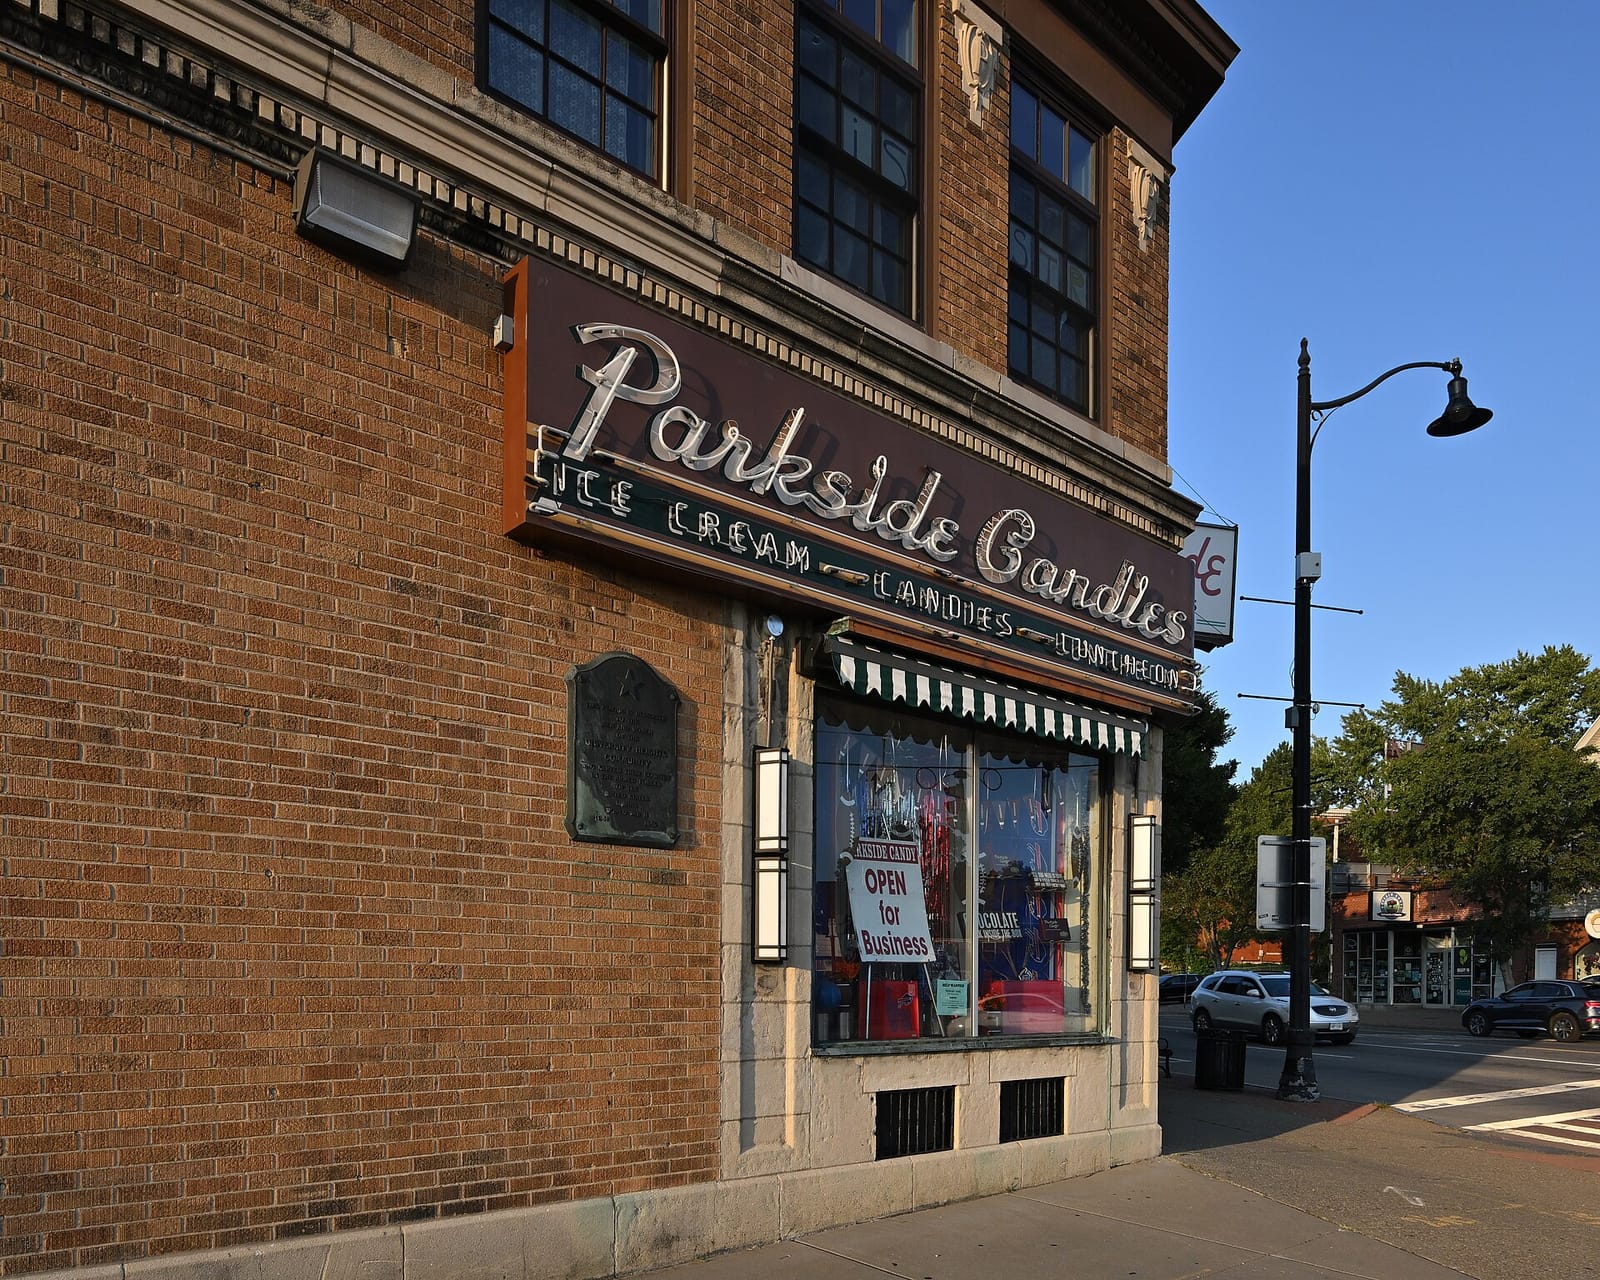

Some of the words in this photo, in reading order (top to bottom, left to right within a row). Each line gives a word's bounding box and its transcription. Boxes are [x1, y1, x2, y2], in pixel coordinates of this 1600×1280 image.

[562, 321, 959, 562] Parkside
[976, 508, 1187, 645] Candies
[552, 462, 634, 517] ICE
[668, 502, 810, 573] CREAM
[873, 571, 1013, 638] CANDIES
[1055, 632, 1180, 691] LUNCHEON
[889, 846, 917, 861] CANDY
[865, 868, 907, 896] OPEN
[879, 899, 900, 926] for
[861, 929, 929, 956] Business
